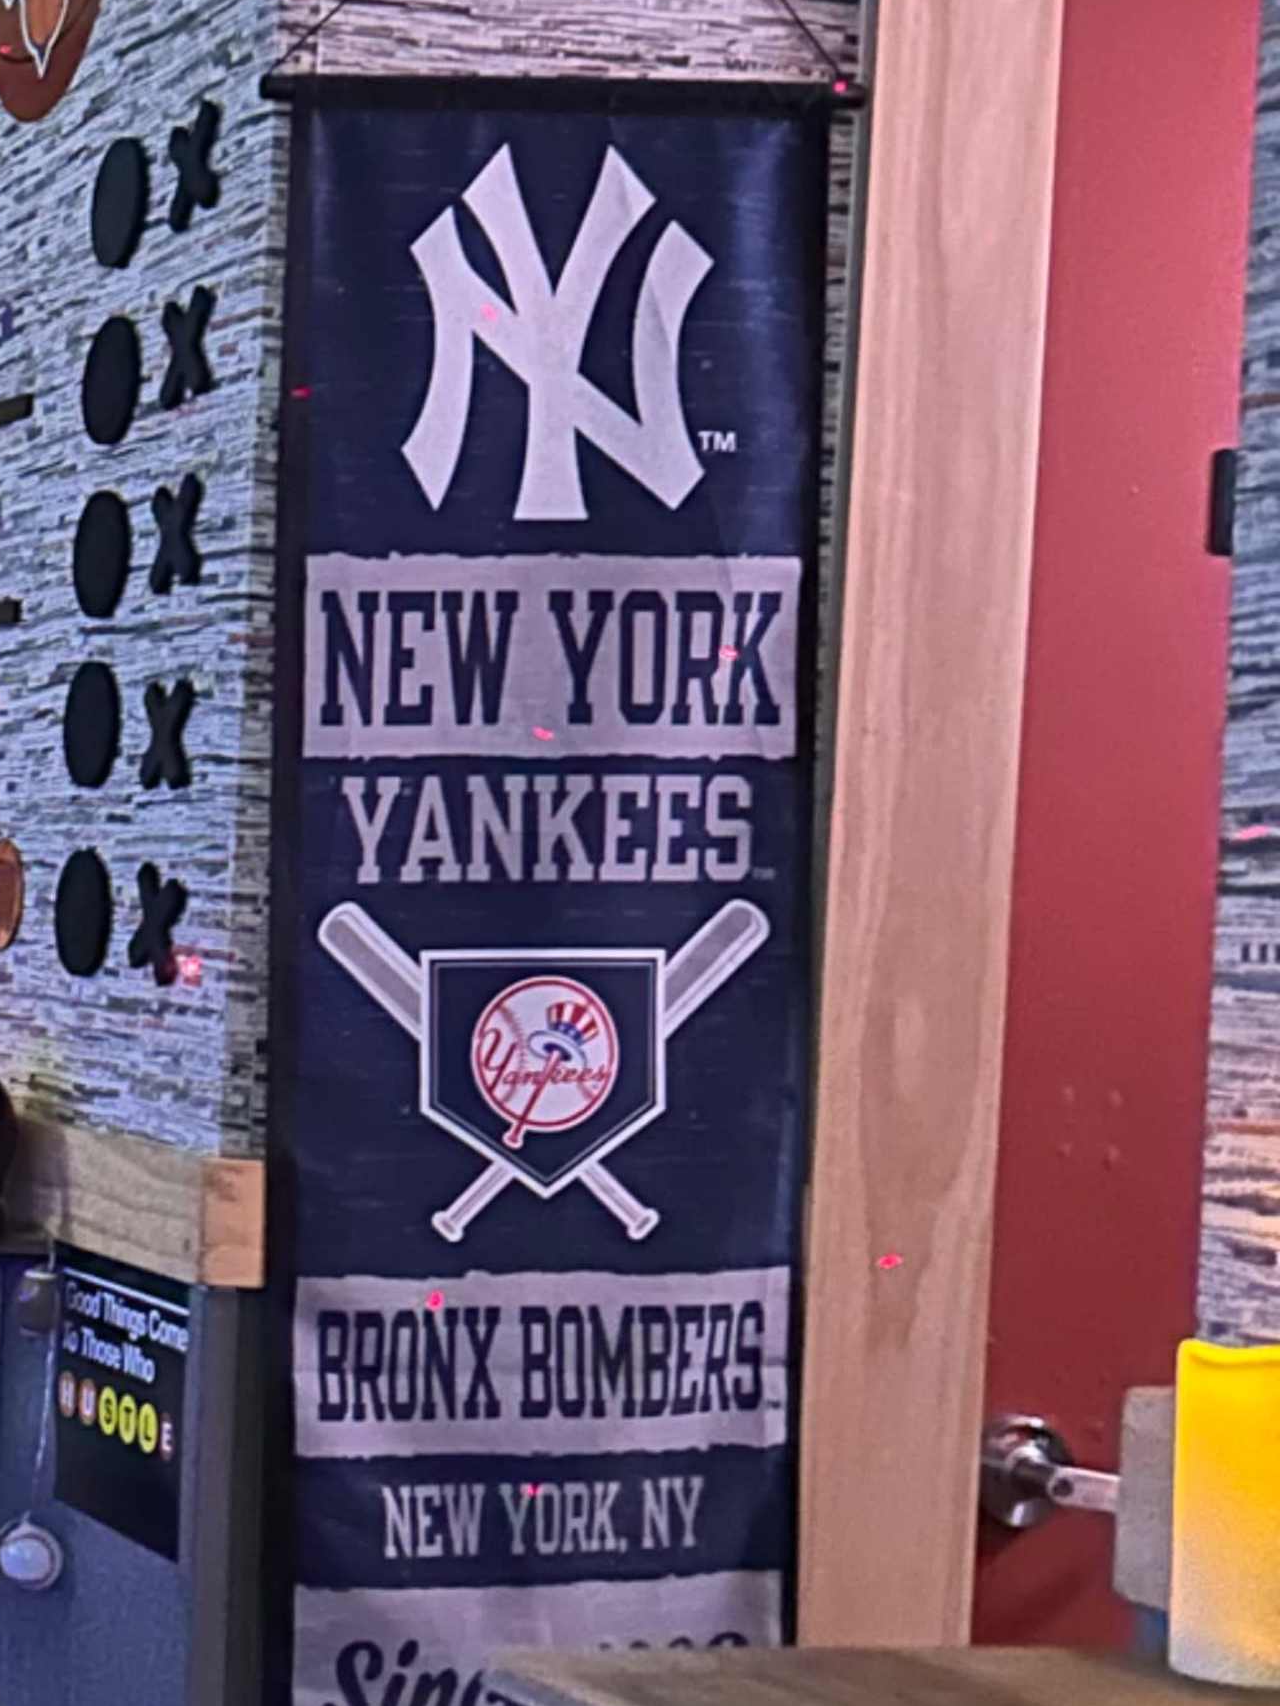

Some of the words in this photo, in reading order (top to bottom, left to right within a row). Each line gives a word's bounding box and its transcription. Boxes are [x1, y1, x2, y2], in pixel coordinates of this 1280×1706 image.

[320, 589, 519, 727] NEW
[549, 589, 782, 727] YORK
[341, 775, 753, 884] YANKEES
[481, 1027, 610, 1094] Yankees
[62, 1321, 79, 1353] To
[80, 1327, 122, 1370] Those
[122, 1342, 156, 1384] Who
[65, 1280, 101, 1320] Good
[102, 1291, 147, 1341] Things
[148, 1309, 189, 1352] Come
[317, 1308, 501, 1423] BRONX
[519, 1300, 766, 1423] BOMBERS
[382, 1485, 482, 1558] NEW
[499, 1482, 629, 1558] YORK,
[643, 1477, 705, 1552] NY
